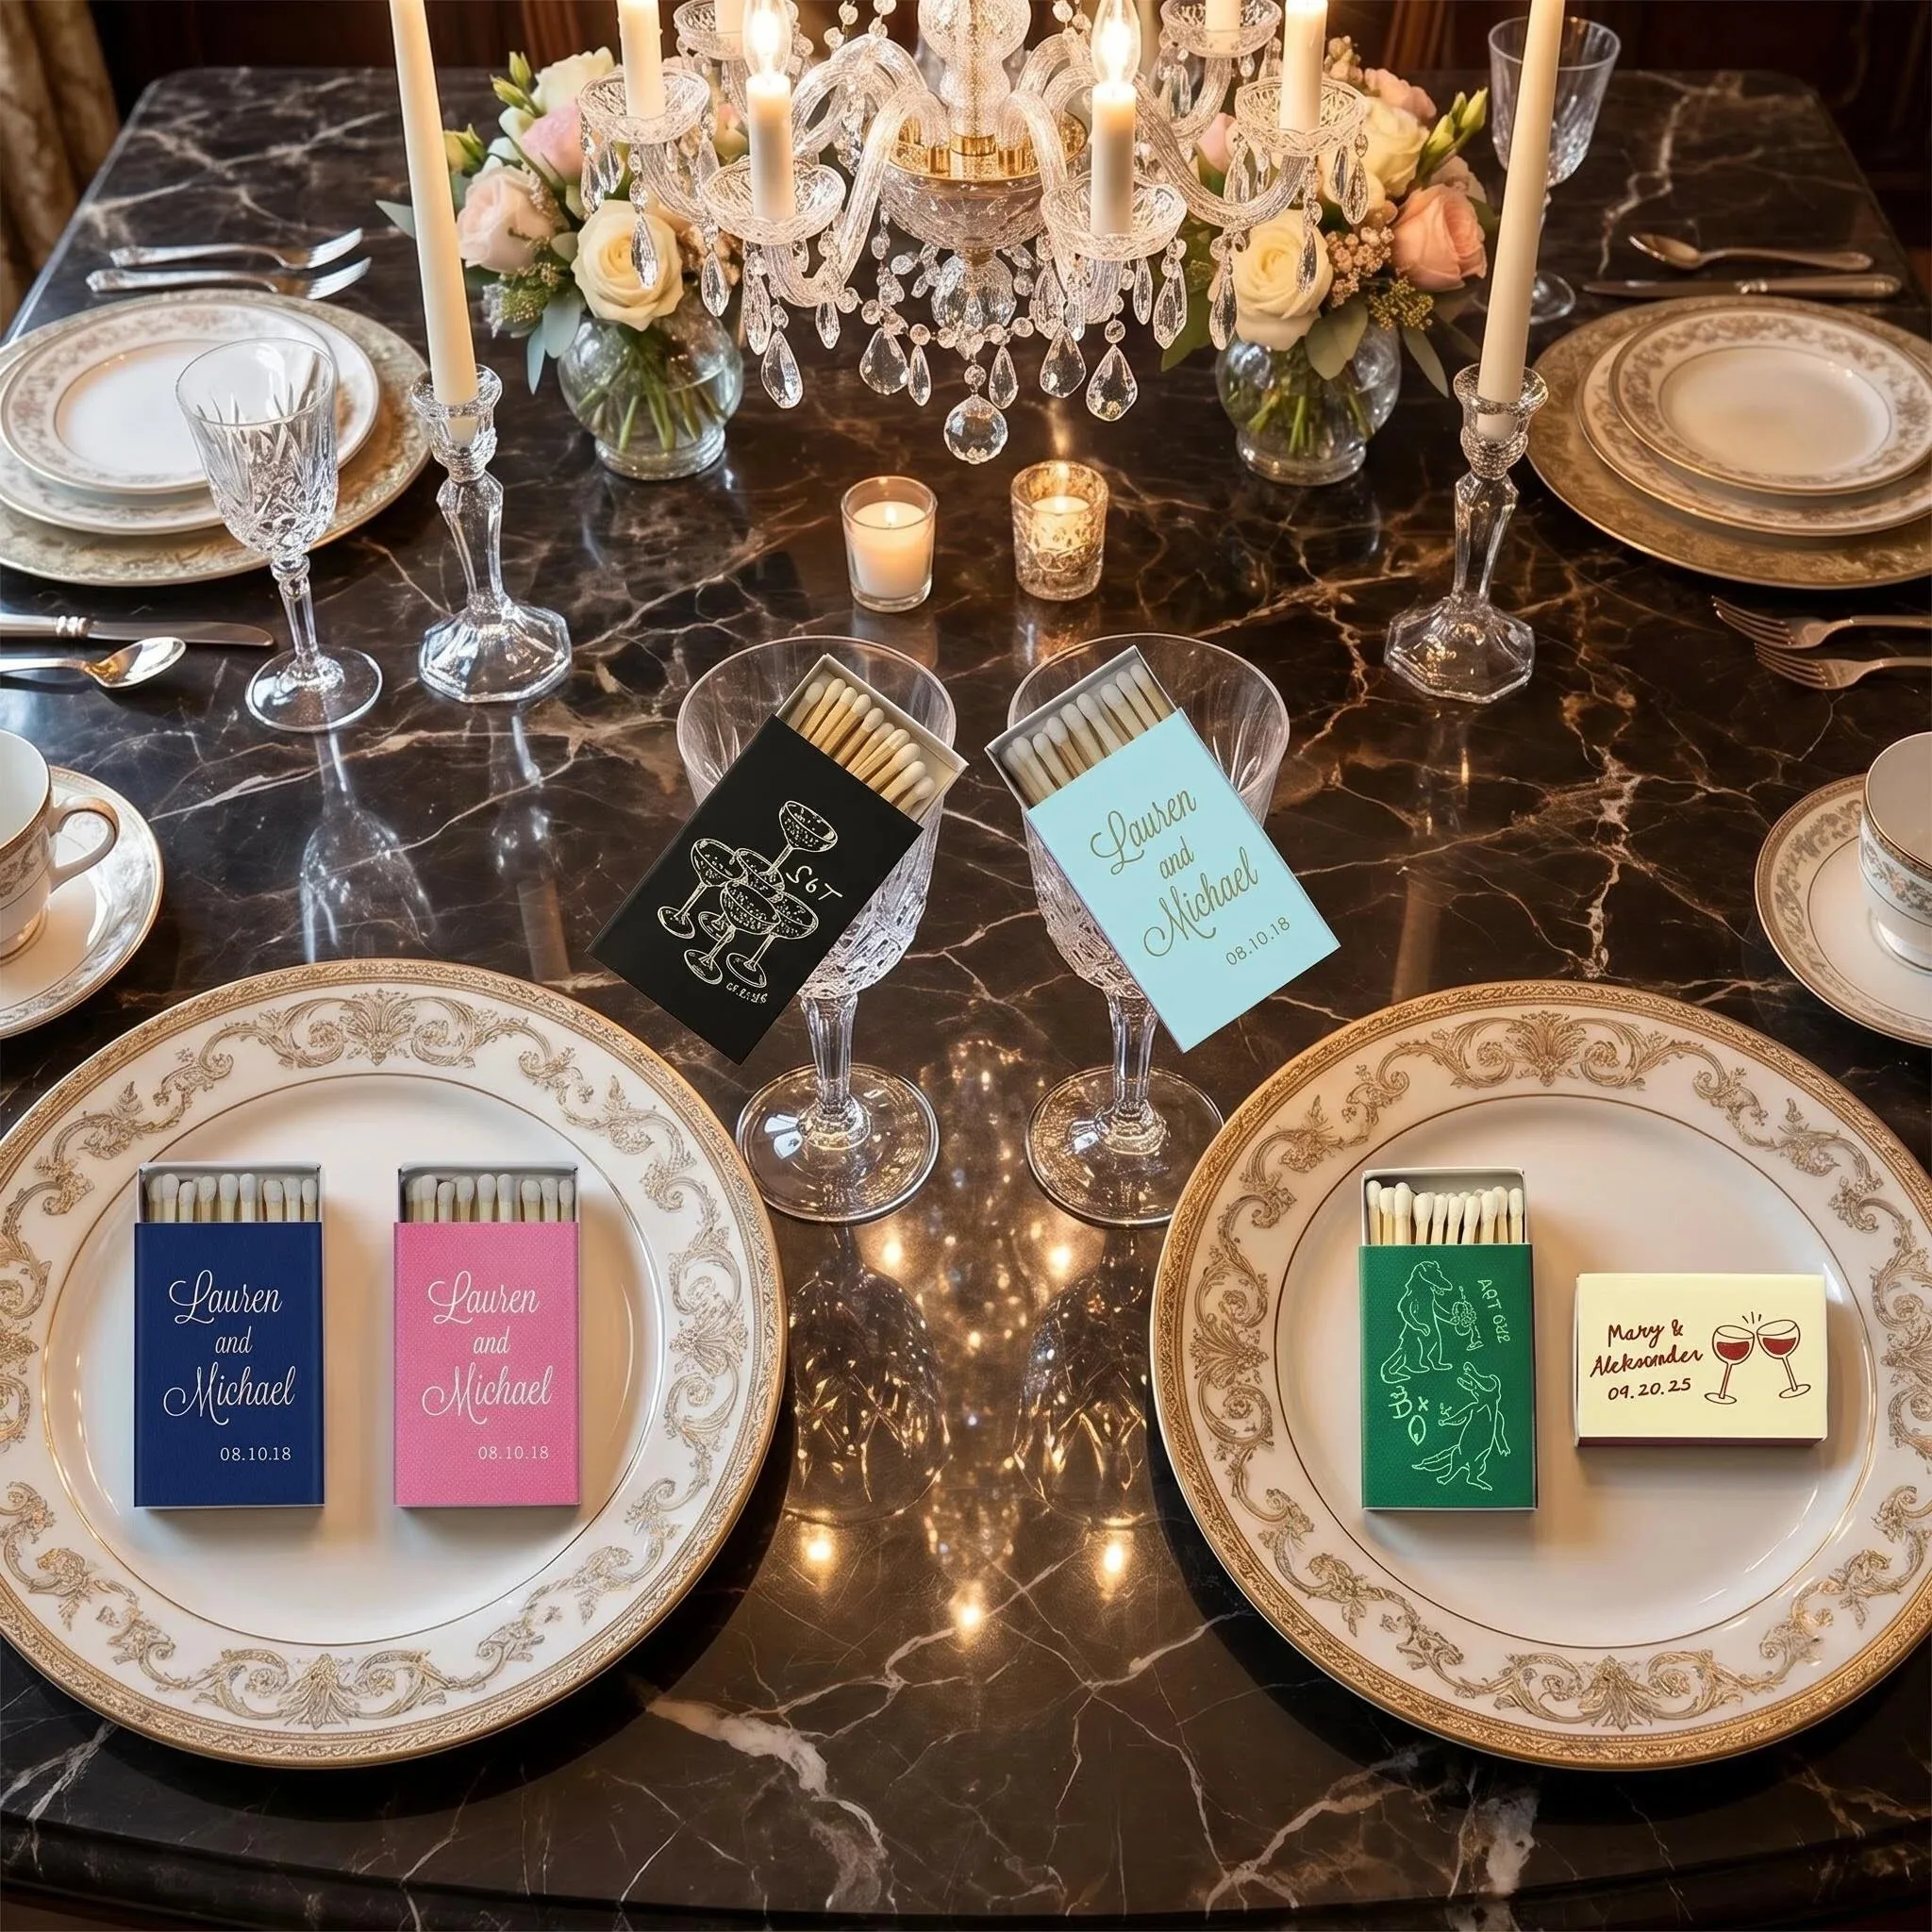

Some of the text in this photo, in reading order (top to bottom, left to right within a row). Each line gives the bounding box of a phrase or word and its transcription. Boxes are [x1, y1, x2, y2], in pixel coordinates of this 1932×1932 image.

[1090, 789, 1198, 876] Lauren
[1158, 836, 1195, 879] and
[1143, 845, 1258, 958] Michael
[1225, 916, 1291, 967] 08.10.18
[168, 1269, 282, 1324] Lauren
[427, 1270, 540, 1324] Lauren
[214, 1326, 253, 1355] and
[472, 1326, 510, 1355] and
[1607, 1319, 1684, 1348] Mary &
[162, 1362, 296, 1426] Michael
[421, 1362, 554, 1426] Michael
[1607, 1377, 1692, 1401] 09.20.25
[219, 1446, 291, 1462] 08.10.18
[477, 1445, 549, 1460] 08.10.18
